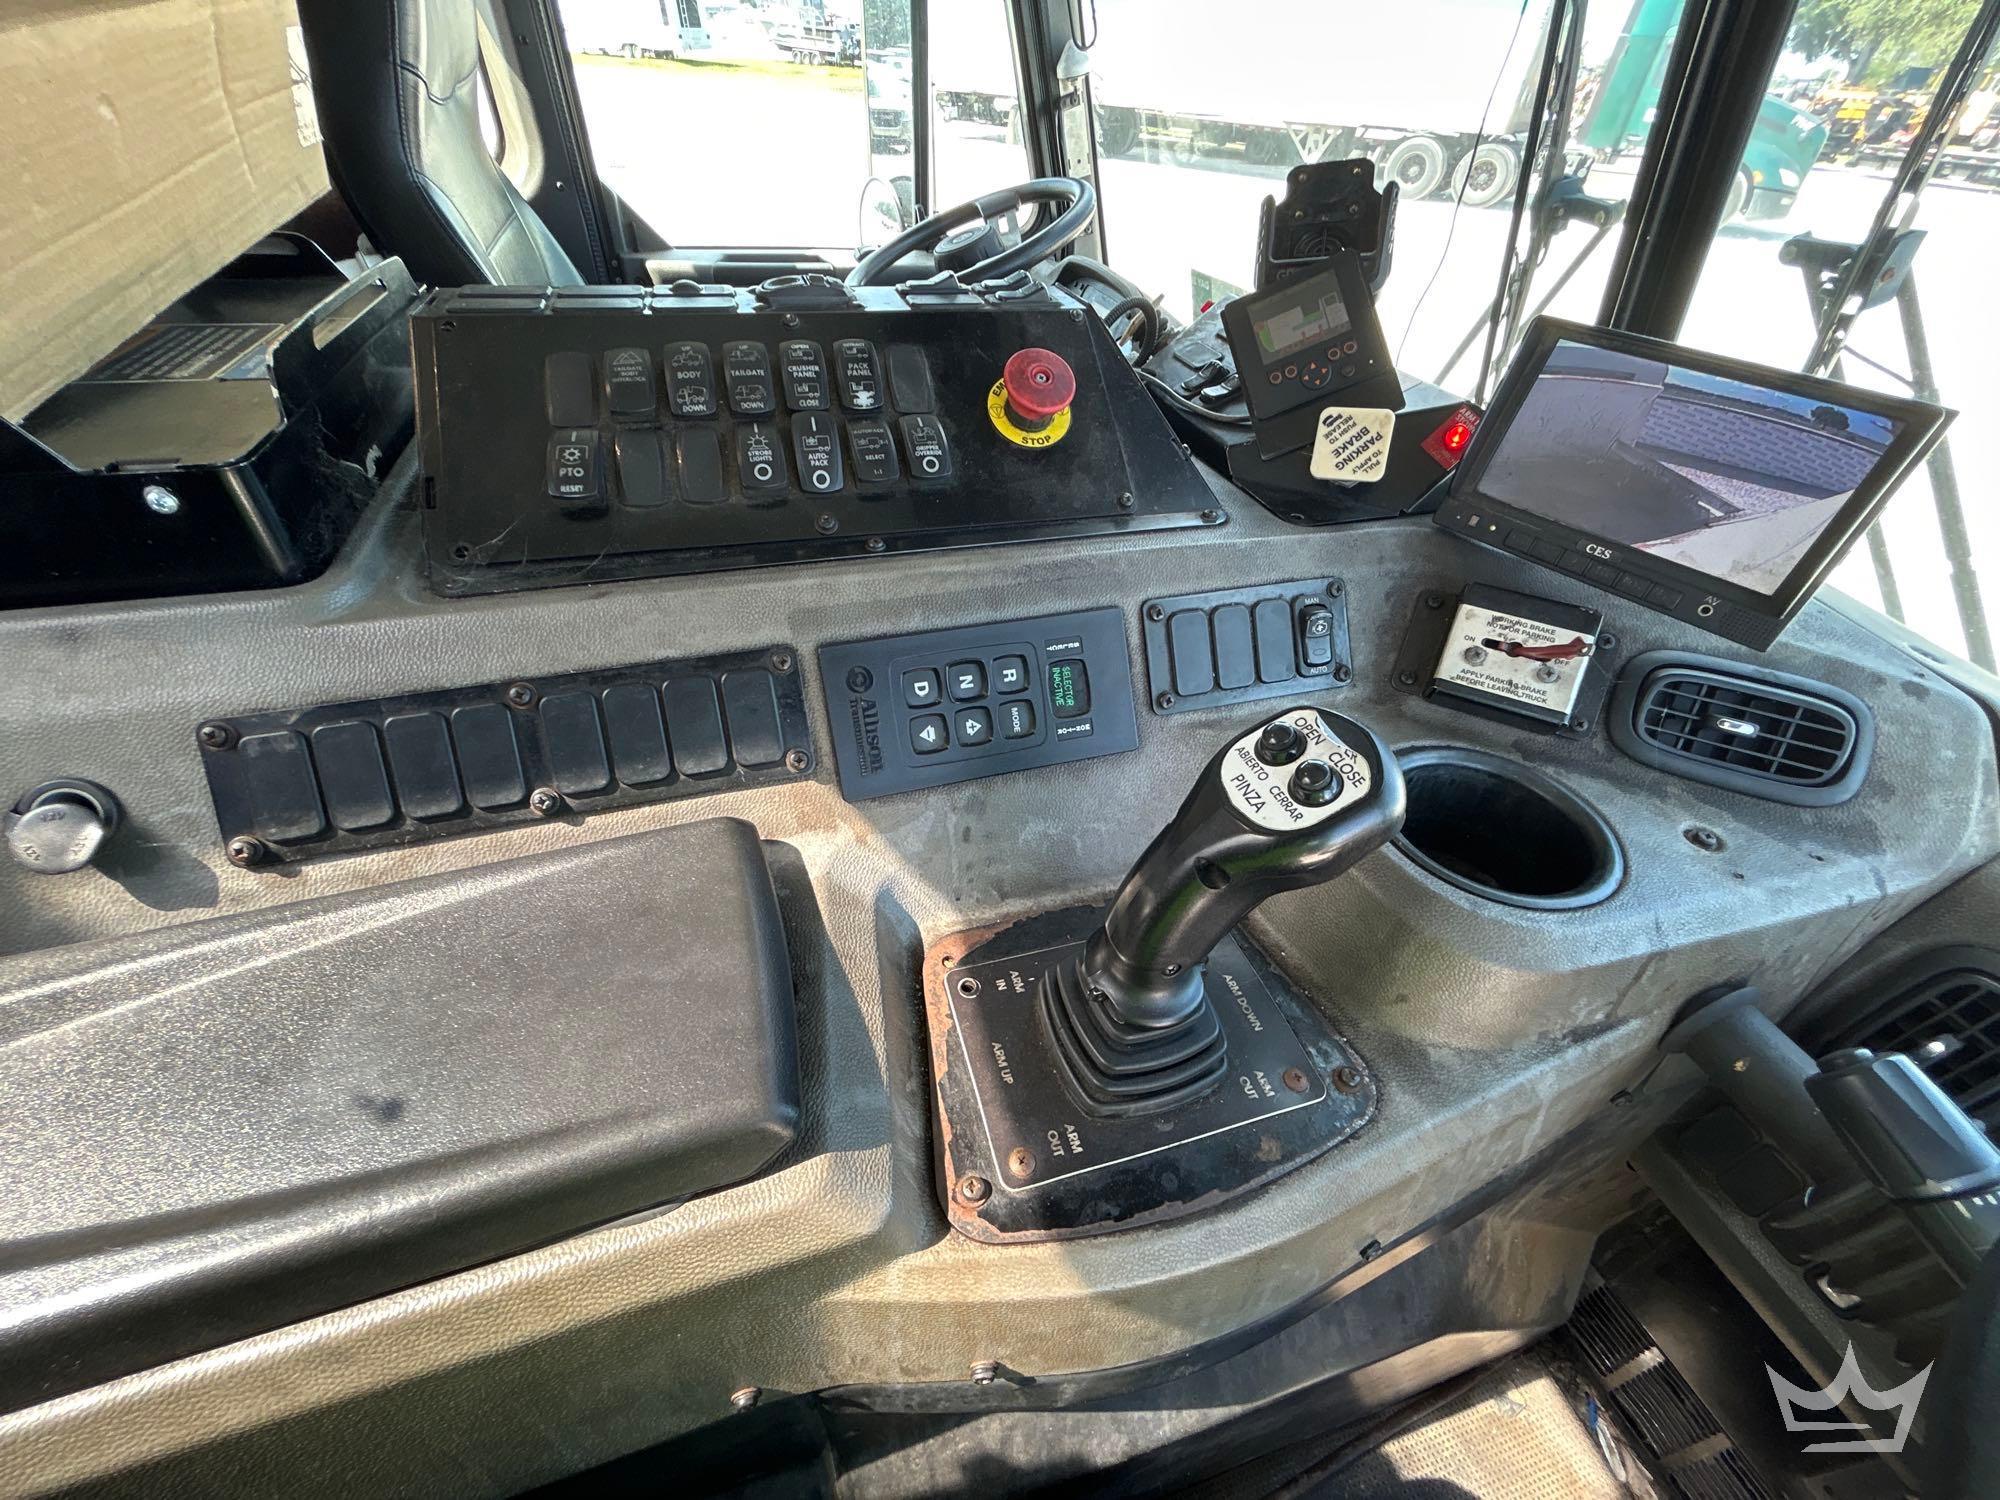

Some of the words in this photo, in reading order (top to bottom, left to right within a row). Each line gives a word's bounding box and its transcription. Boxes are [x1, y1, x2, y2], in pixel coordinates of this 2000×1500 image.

[676, 371, 702, 379] BODY
[730, 369, 765, 377] TAILGATE
[788, 365, 820, 373] CRUSHER
[847, 369, 872, 377] PANEL
[682, 404, 706, 412] DOWN
[740, 401, 764, 410] DOWN
[1459, 408, 1477, 422] ARM
[1323, 414, 1354, 440] RELEASE
[1339, 421, 1357, 436] PUSH
[1021, 434, 1052, 446] STOP
[1329, 434, 1340, 444] TO
[1332, 426, 1370, 458] BRAKE
[914, 450, 942, 458] OVERRIDE
[1335, 432, 1384, 471] PARKING
[1372, 450, 1383, 458] TO
[559, 467, 584, 477] PTO
[1352, 457, 1372, 475] APPLY
[1364, 460, 1380, 475] PULL
[560, 484, 584, 493] RESET
[1586, 543, 1612, 560] CES
[1704, 594, 1720, 606] AV
[1464, 634, 1476, 642] ON
[1522, 630, 1556, 643] PARKING
[1529, 624, 1556, 636] BRAKE
[1554, 658, 1570, 666] OFF
[959, 675, 974, 690] N
[1002, 669, 1017, 682] R
[1460, 668, 1484, 680] APPLY
[1520, 684, 1548, 696] BRAKE
[914, 681, 929, 698] D
[1052, 667, 1064, 706] INACTIVE
[1062, 666, 1074, 706] SELECTOR
[1456, 674, 1486, 688] BEFORE
[1486, 682, 1519, 696] LEAVING
[1520, 691, 1548, 704] TRUCK
[1010, 707, 1020, 733] MODE
[860, 699, 884, 774] Allison
[1294, 717, 1326, 746] OPEN
[1234, 746, 1269, 781] ABIERTO
[1328, 752, 1366, 788] CLOSE
[1230, 774, 1266, 814] PINZA
[1269, 785, 1304, 822] CERRAR
[995, 979, 1006, 992] IN
[1009, 970, 1025, 994] ARM
[1222, 974, 1243, 999] ARM
[1236, 995, 1264, 1032] DOWN
[992, 1042, 1008, 1068] ARM
[1001, 1064, 1014, 1085] UP
[1238, 1076, 1260, 1100] OUT
[1253, 1070, 1276, 1098] ARM
[1046, 1130, 1065, 1158] OUT
[1063, 1124, 1084, 1154] ARM
